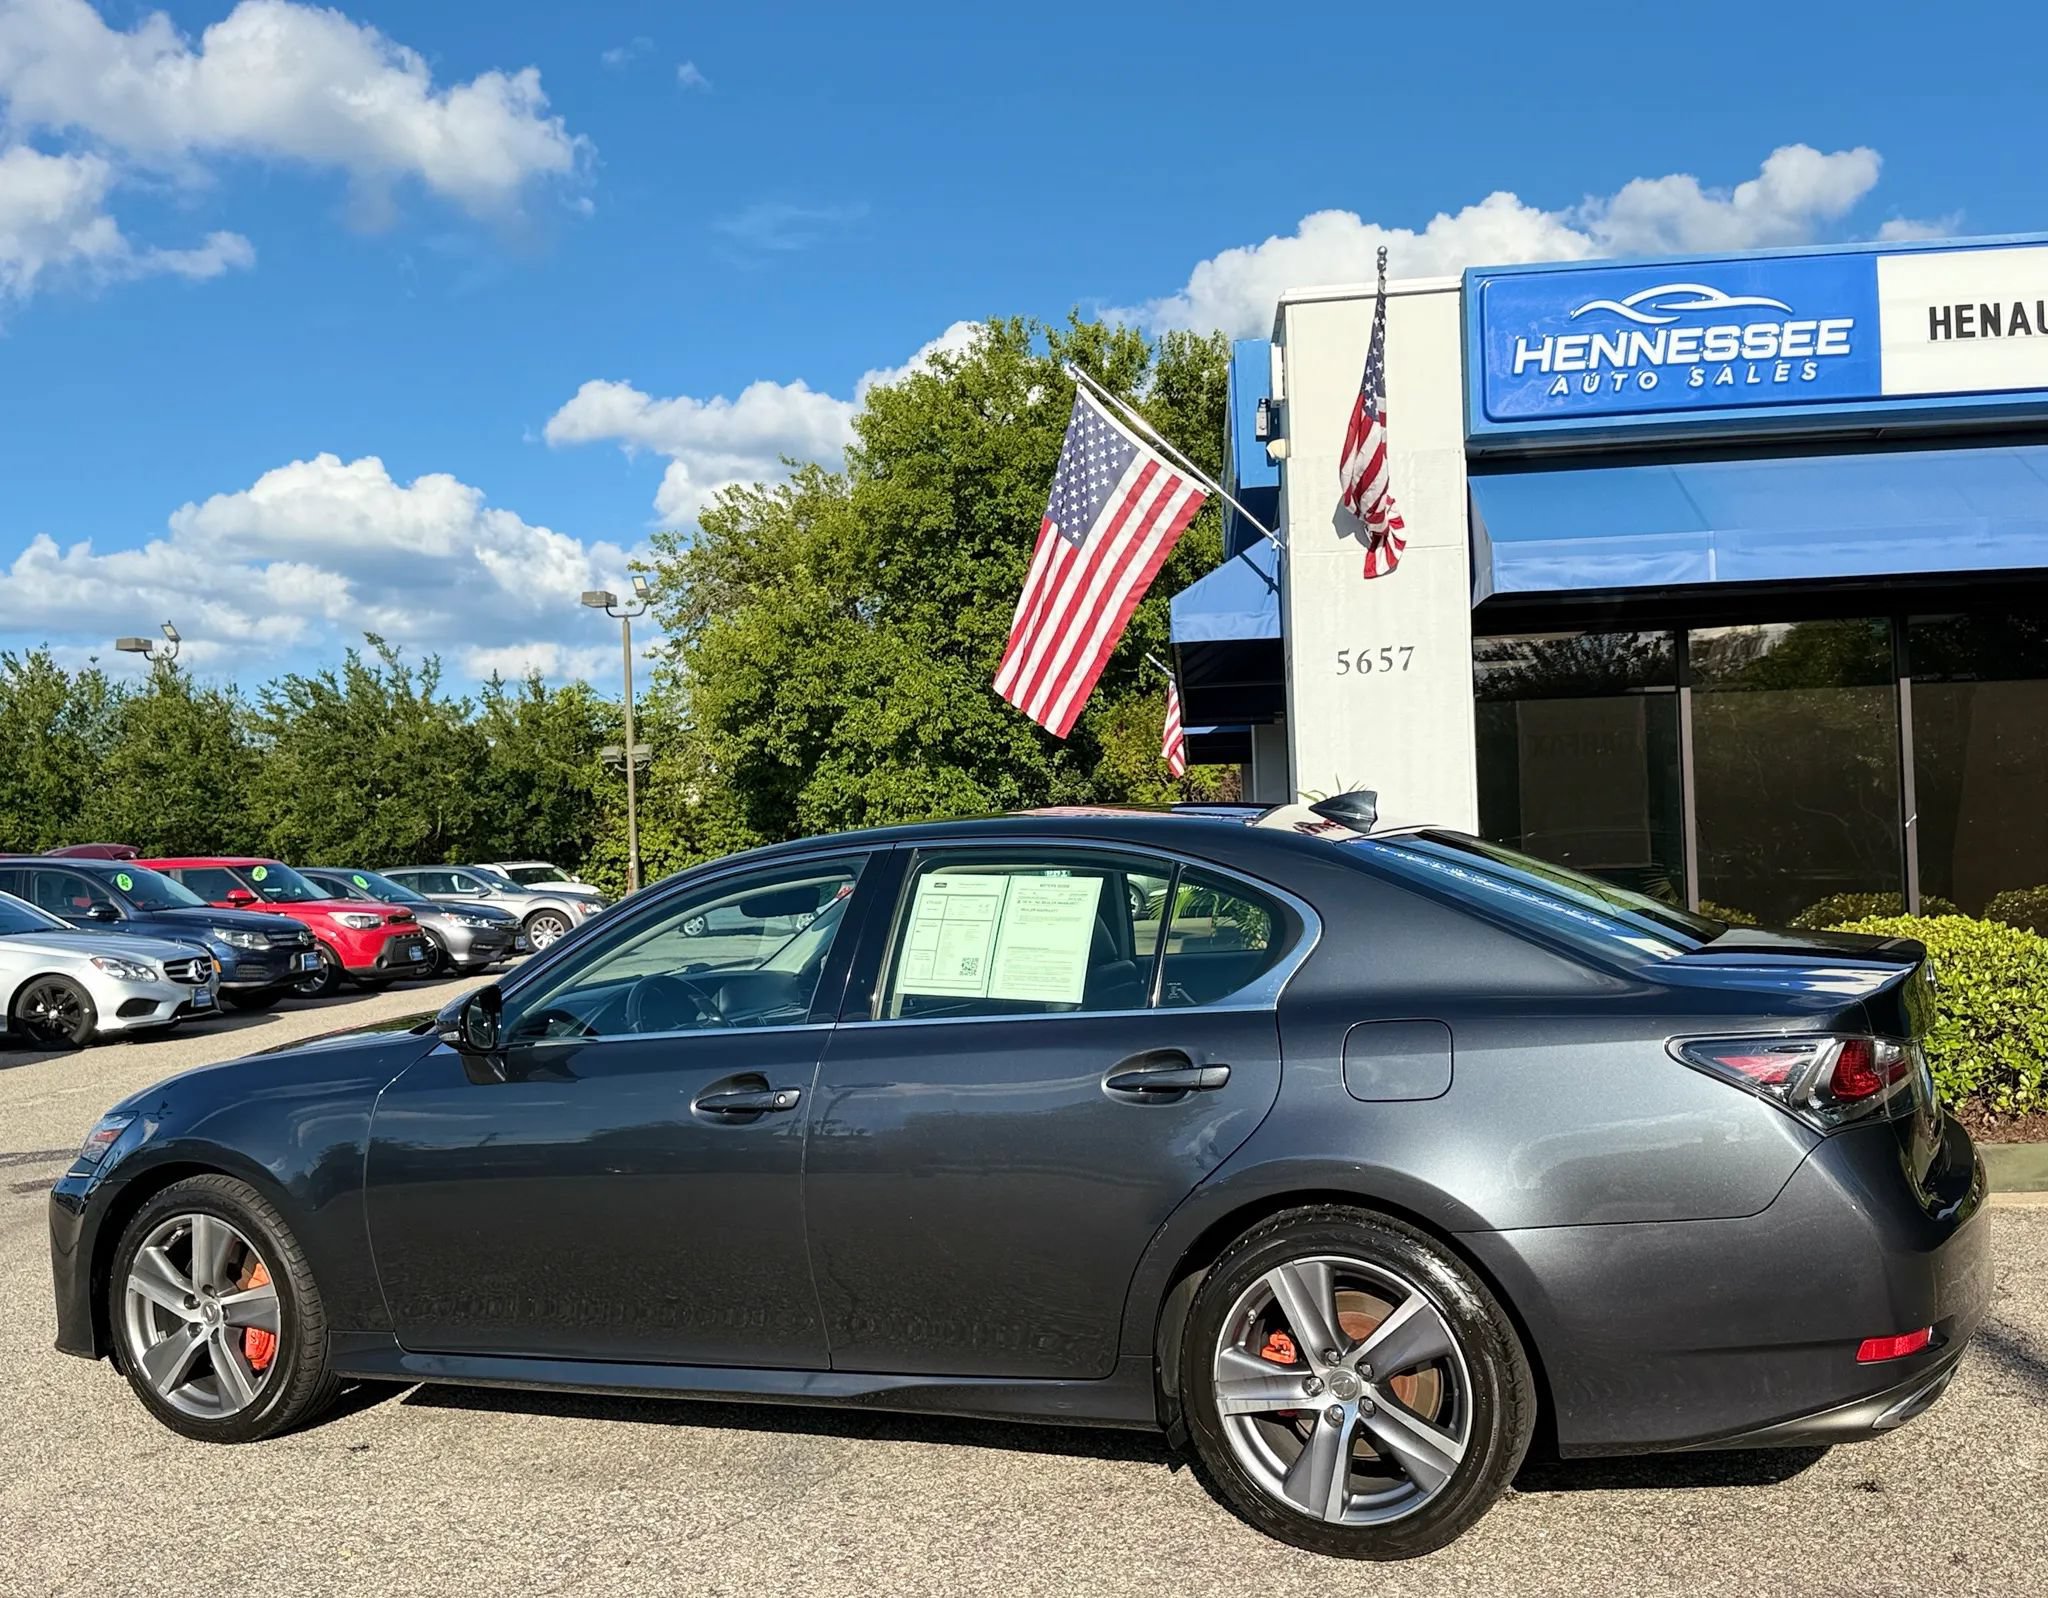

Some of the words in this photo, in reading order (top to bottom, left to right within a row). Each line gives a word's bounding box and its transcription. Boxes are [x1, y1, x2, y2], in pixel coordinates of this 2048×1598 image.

[1512, 317, 1855, 375] HENNESSEE
[1550, 370, 1658, 396] AUTO
[1688, 360, 1818, 387] SALES
[1336, 645, 1415, 676] 5657
